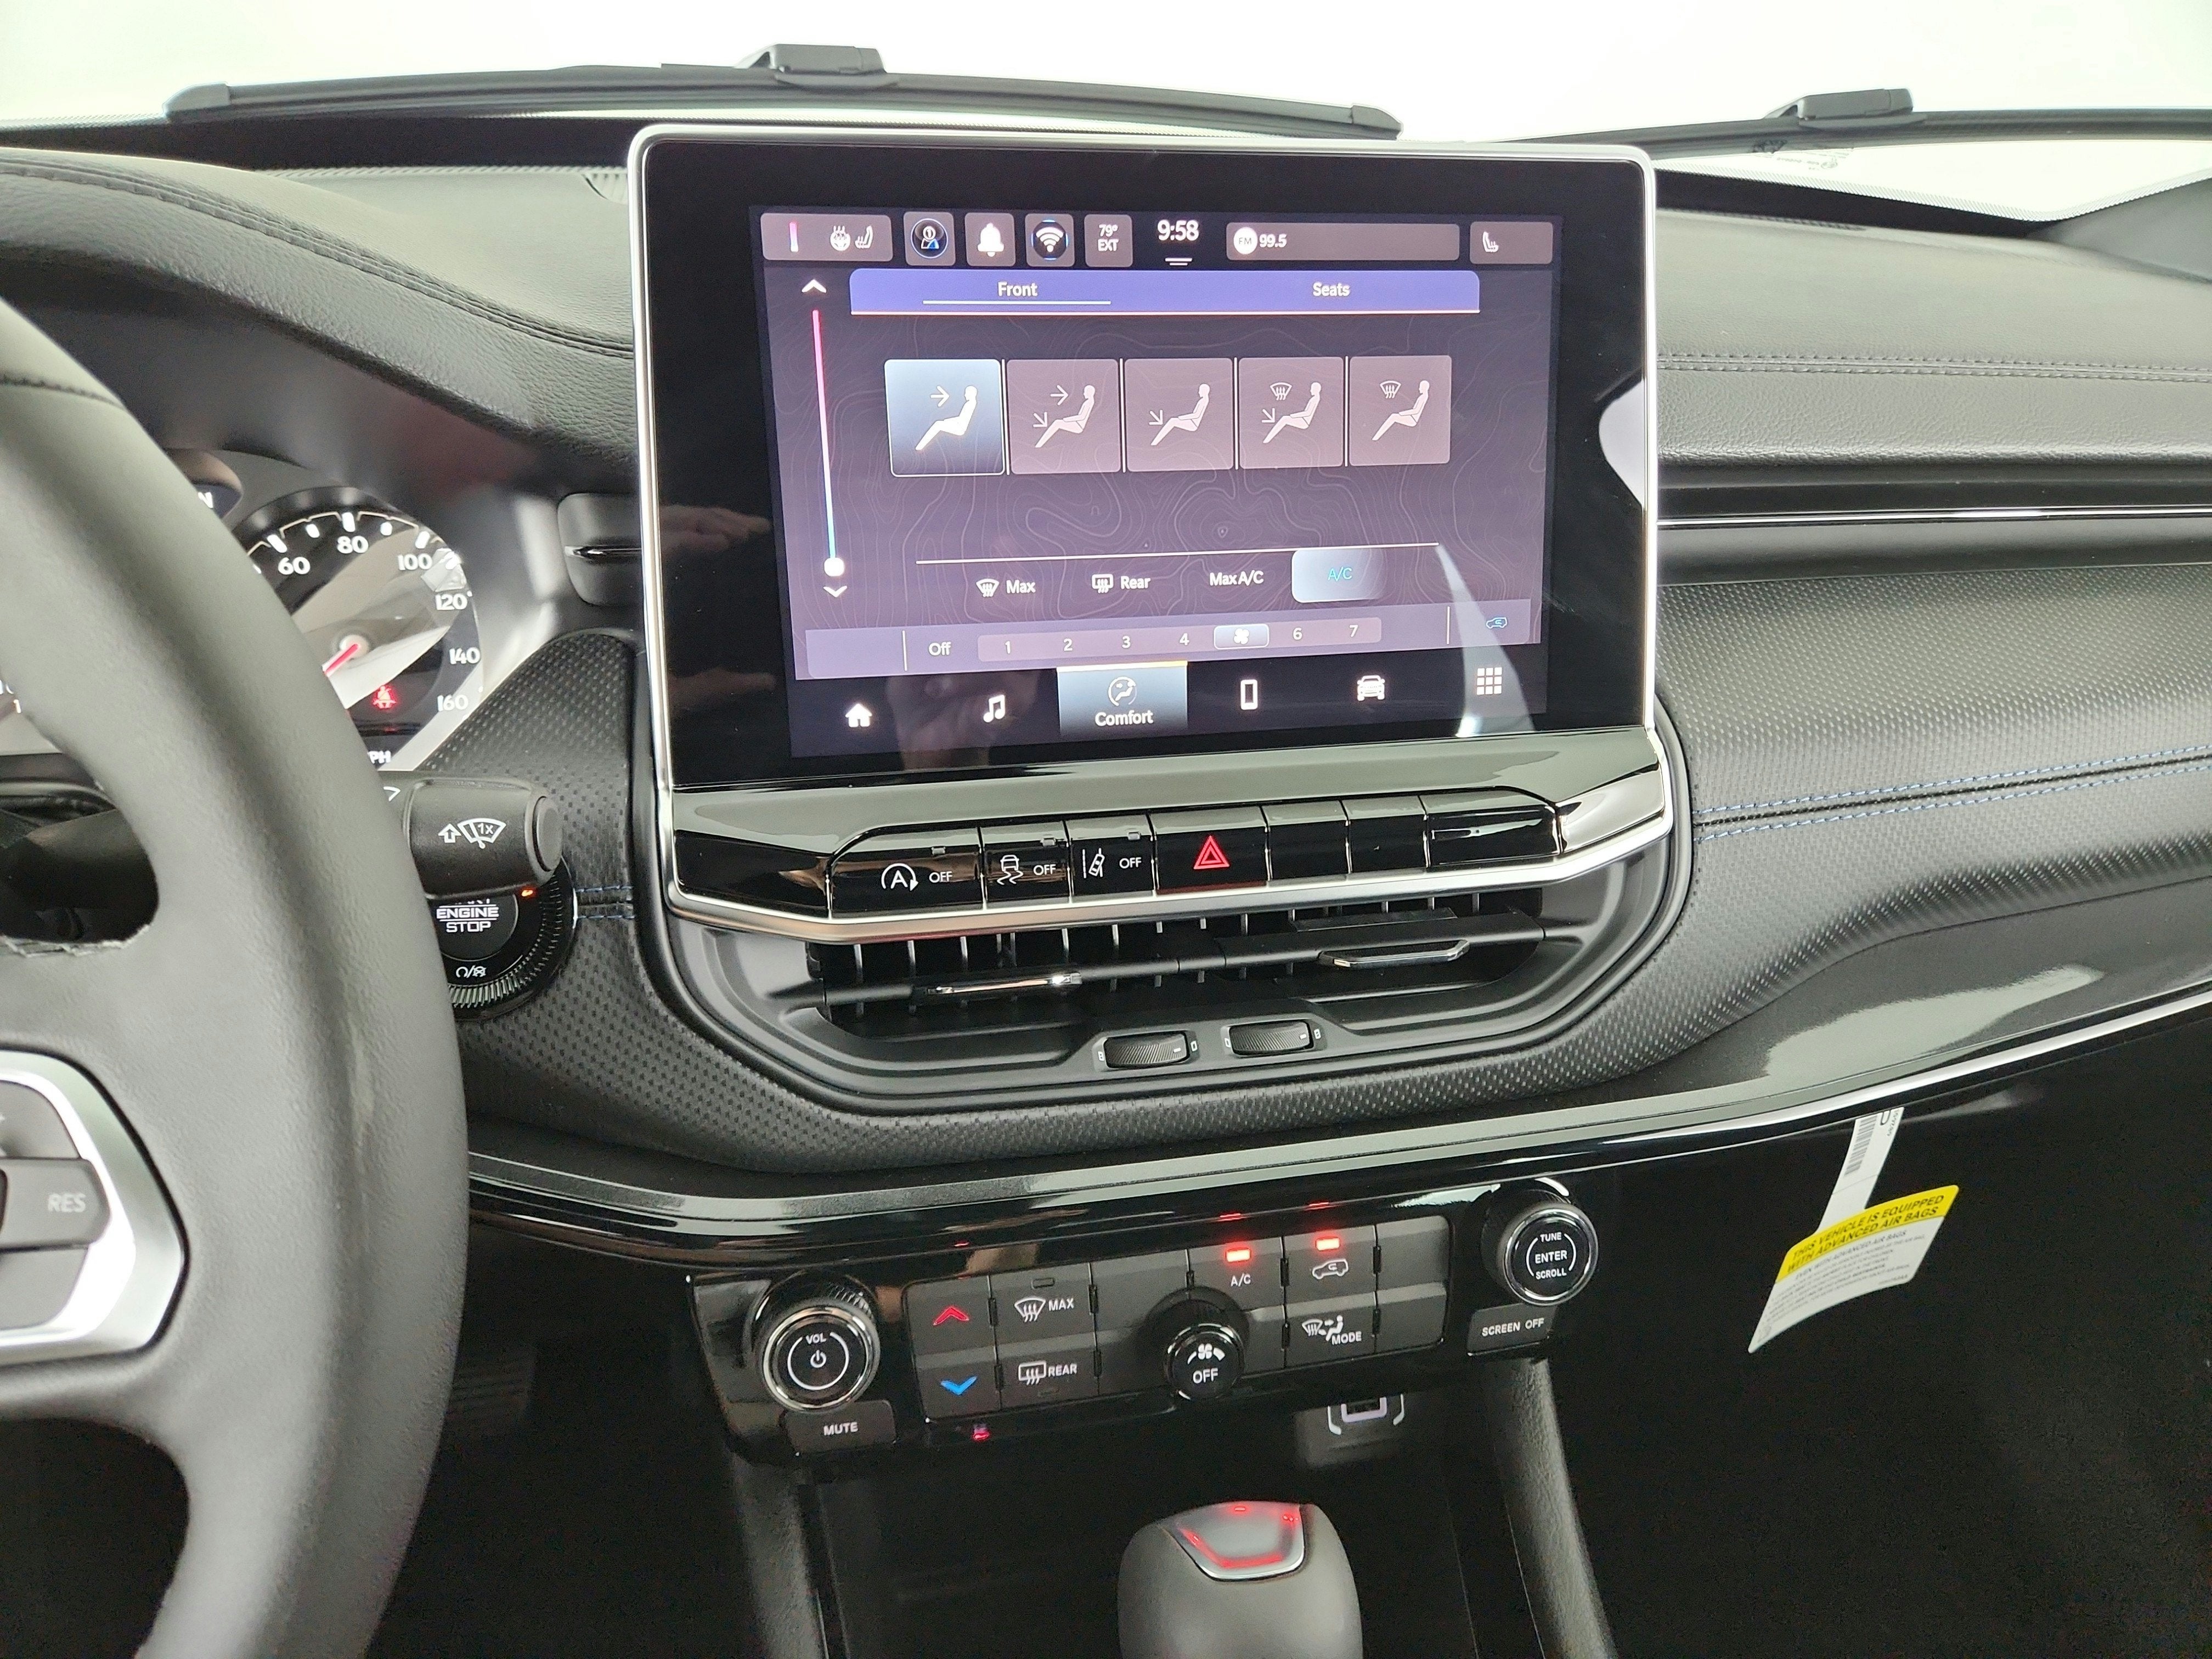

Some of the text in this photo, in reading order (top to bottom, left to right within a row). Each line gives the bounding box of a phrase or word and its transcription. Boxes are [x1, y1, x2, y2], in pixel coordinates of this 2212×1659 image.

[1157, 219, 1200, 241] 9:58
[1098, 239, 1119, 252] EXT
[1238, 233, 1288, 248] FM 99.5
[997, 281, 1038, 298] Front
[1312, 282, 1351, 297] Seats
[337, 535, 369, 554] 80
[278, 556, 311, 575] 60
[397, 554, 432, 571] 100
[1328, 567, 1352, 582] A/C
[1006, 580, 1036, 595] Max
[1120, 575, 1151, 590] Rear
[435, 592, 467, 611] 120
[1005, 624, 1358, 654] 1 2 3 4 6 7
[449, 647, 481, 664] 140
[928, 641, 951, 656] Off
[437, 694, 469, 712] 160
[1095, 710, 1154, 727] Comfort
[367, 750, 392, 764] PH
[1033, 864, 1056, 876] OFF
[1119, 857, 1142, 869] OFF
[929, 871, 952, 883] OFF
[436, 906, 500, 919] ENGINE
[446, 921, 492, 933] STOP
[48, 1192, 86, 1213] RES
[1819, 1217, 1866, 1244] VEHICLE
[1867, 1212, 1880, 1223] IS
[1881, 1195, 1944, 1218] EQUIPPED
[1540, 1232, 1562, 1243] TUNE
[1815, 1223, 1878, 1254] ADVANCED
[1880, 1215, 1902, 1229] AIR
[1904, 1206, 1938, 1222] BAGS
[1535, 1250, 1567, 1264] ENTER
[1231, 1274, 1251, 1288] A/C
[1536, 1267, 1567, 1280] SCROLL
[1048, 1297, 1075, 1312] MAX
[1481, 1318, 1545, 1336] SCREEN OFF
[806, 1333, 827, 1344] VOL
[1331, 1330, 1362, 1345] MODE
[1048, 1363, 1077, 1376] REAR
[1192, 1368, 1219, 1384] OFF
[823, 1421, 858, 1436] MUTE
